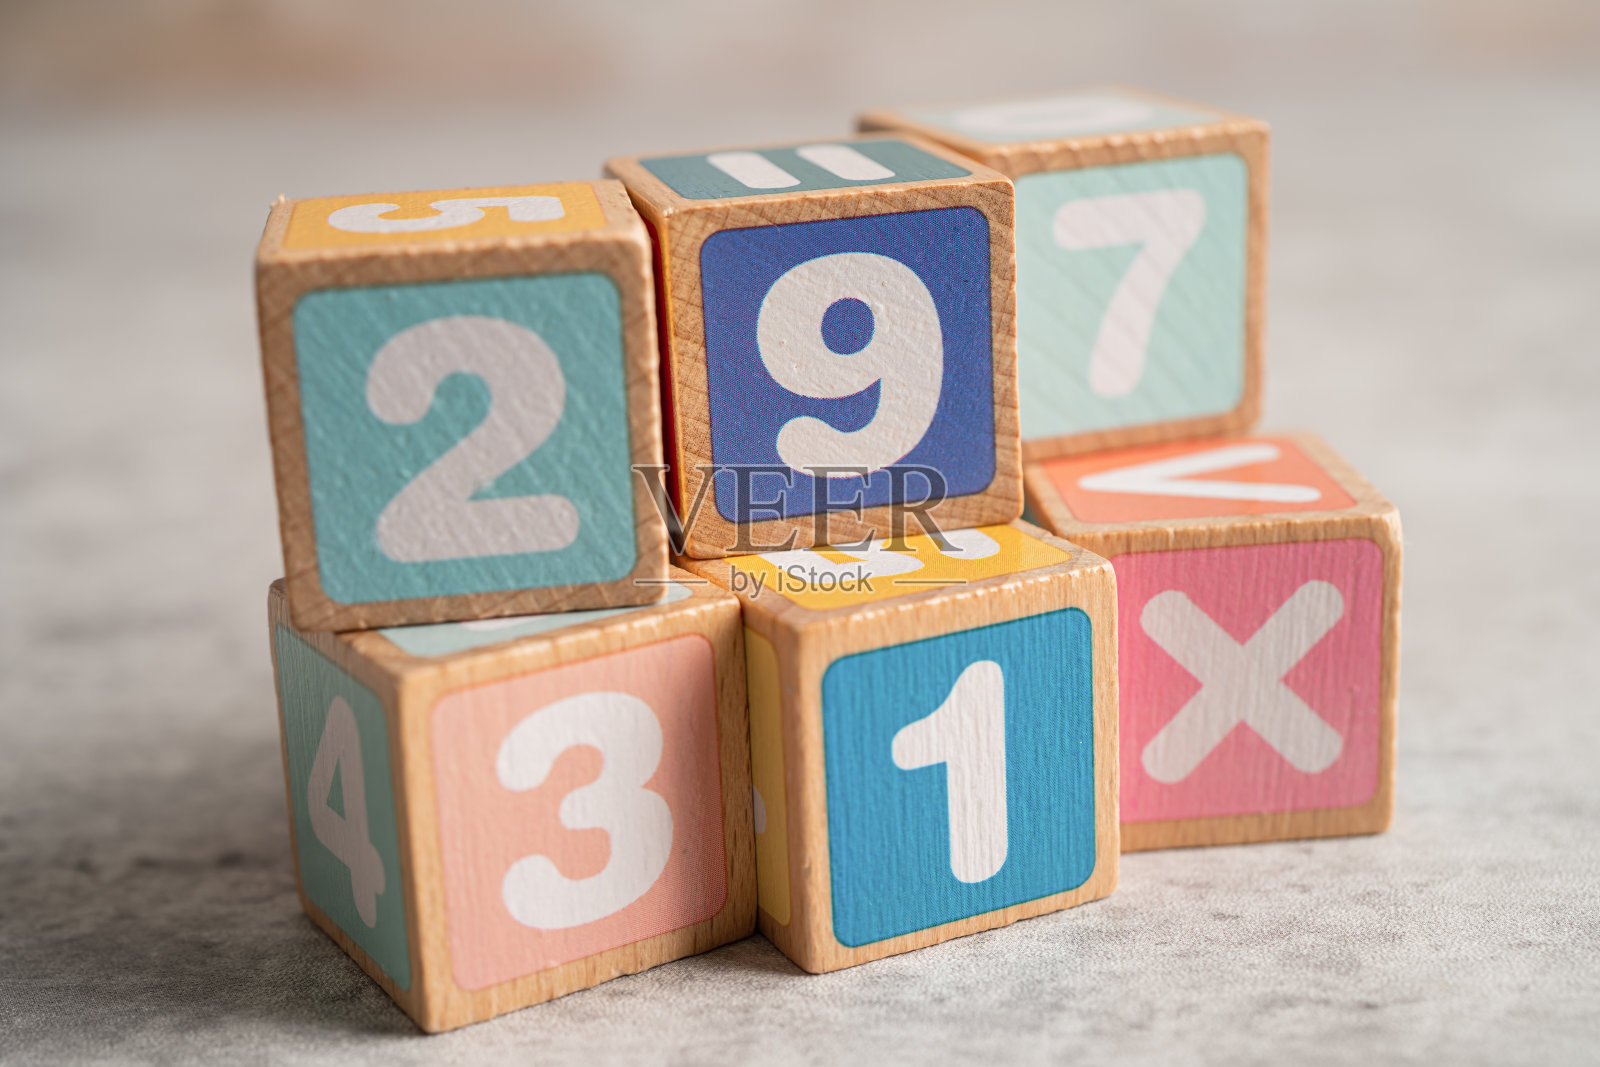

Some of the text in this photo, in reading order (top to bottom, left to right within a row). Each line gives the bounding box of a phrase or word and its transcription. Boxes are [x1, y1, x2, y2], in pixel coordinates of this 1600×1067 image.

[327, 195, 566, 234] 5
[1053, 188, 1206, 398] 7
[365, 315, 580, 564] 2
[756, 251, 944, 479] 9
[308, 696, 385, 928] 4
[495, 691, 673, 930] 3
[891, 660, 1009, 884] 1
